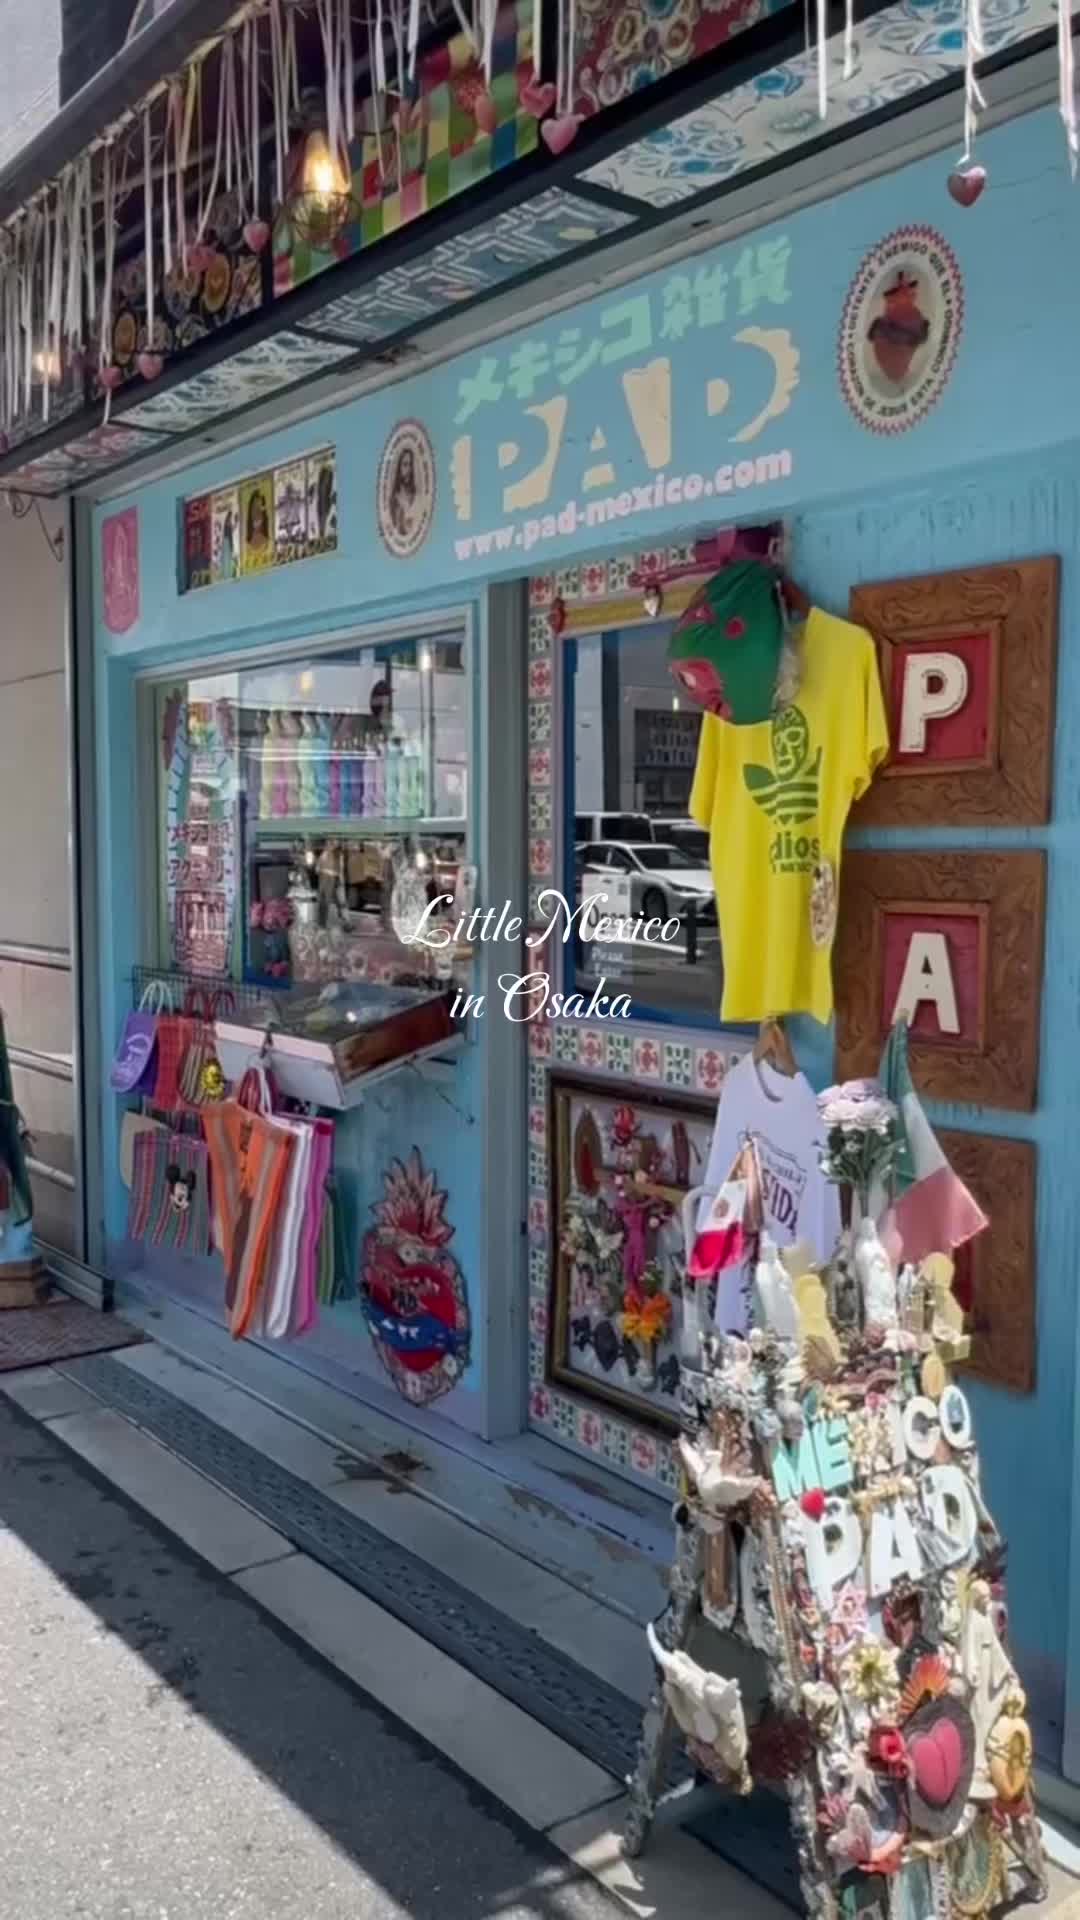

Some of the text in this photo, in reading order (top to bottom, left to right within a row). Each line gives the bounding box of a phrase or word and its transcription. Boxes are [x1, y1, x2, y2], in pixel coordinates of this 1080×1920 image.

[453, 235, 793, 423] メキシコ雑貨
[451, 325, 800, 521] PAD
[454, 449, 793, 561] www.pad-mexico.com
[899, 652, 968, 754] P
[891, 932, 960, 1034] A
[803, 1464, 977, 1611] PAD
